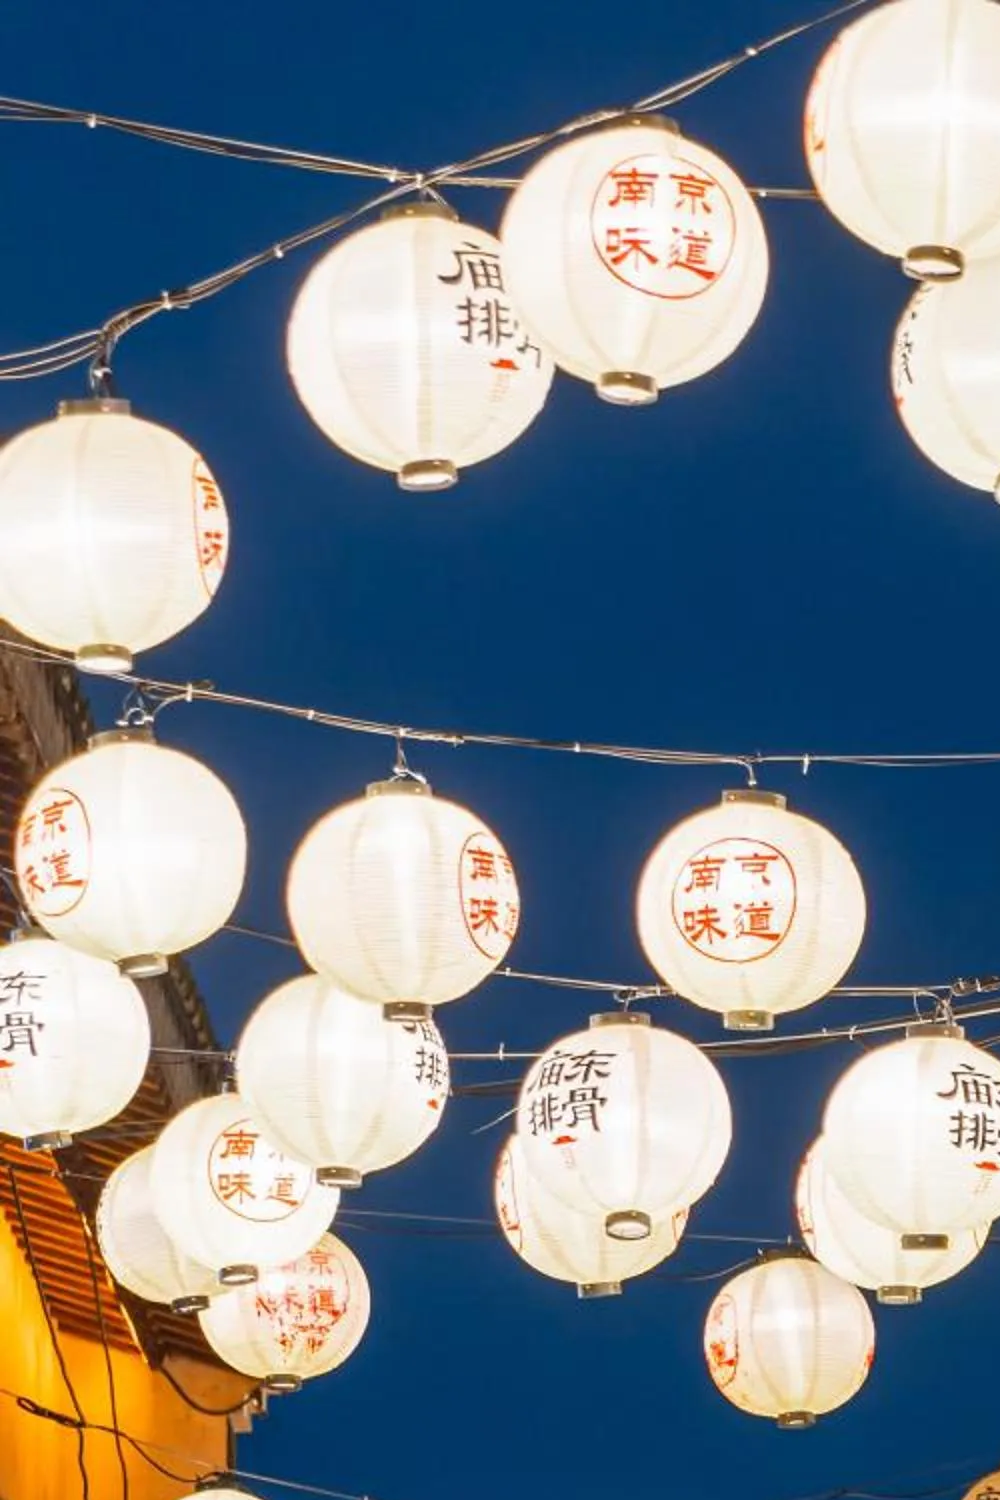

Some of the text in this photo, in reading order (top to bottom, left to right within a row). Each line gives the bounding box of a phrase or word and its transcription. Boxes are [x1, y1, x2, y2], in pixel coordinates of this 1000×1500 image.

[607, 166, 716, 214] 南京
[606, 227, 719, 280] 味道
[684, 852, 780, 894] 南京
[682, 902, 781, 945] 味道
[527, 1048, 617, 1094] 庙东
[528, 1087, 608, 1137] 排骨
[218, 1171, 300, 1208] 味道
